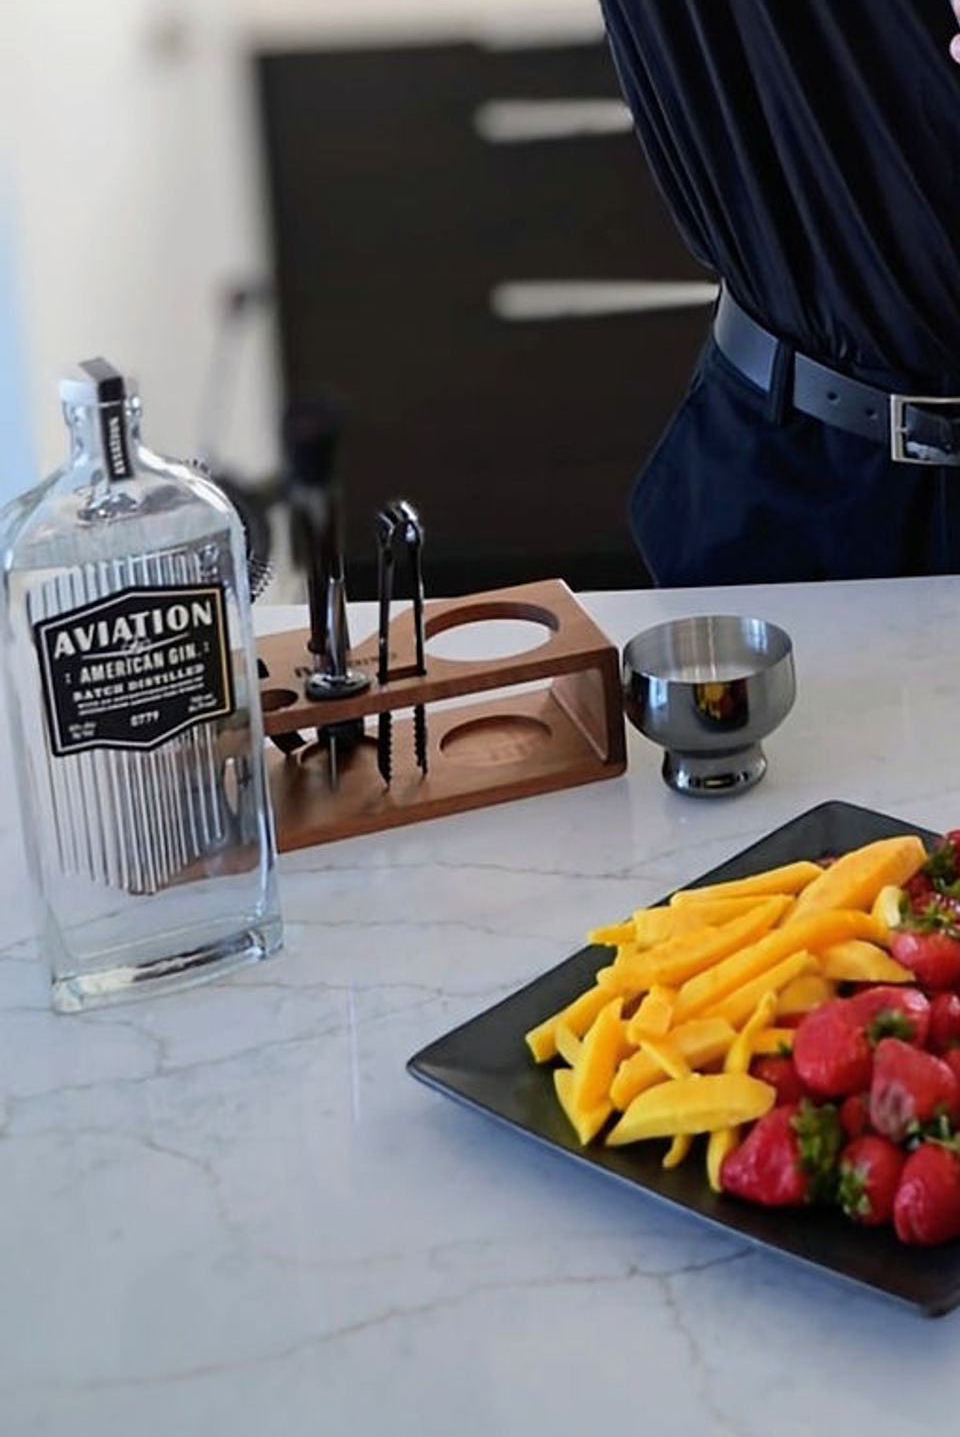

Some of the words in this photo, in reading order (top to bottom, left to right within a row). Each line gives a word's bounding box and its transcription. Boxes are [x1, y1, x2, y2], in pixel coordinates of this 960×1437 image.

[53, 599, 213, 659] AVIATION
[73, 683, 124, 702] BATCH
[127, 663, 205, 691] DISTILLED
[80, 650, 165, 684] AMERICAN
